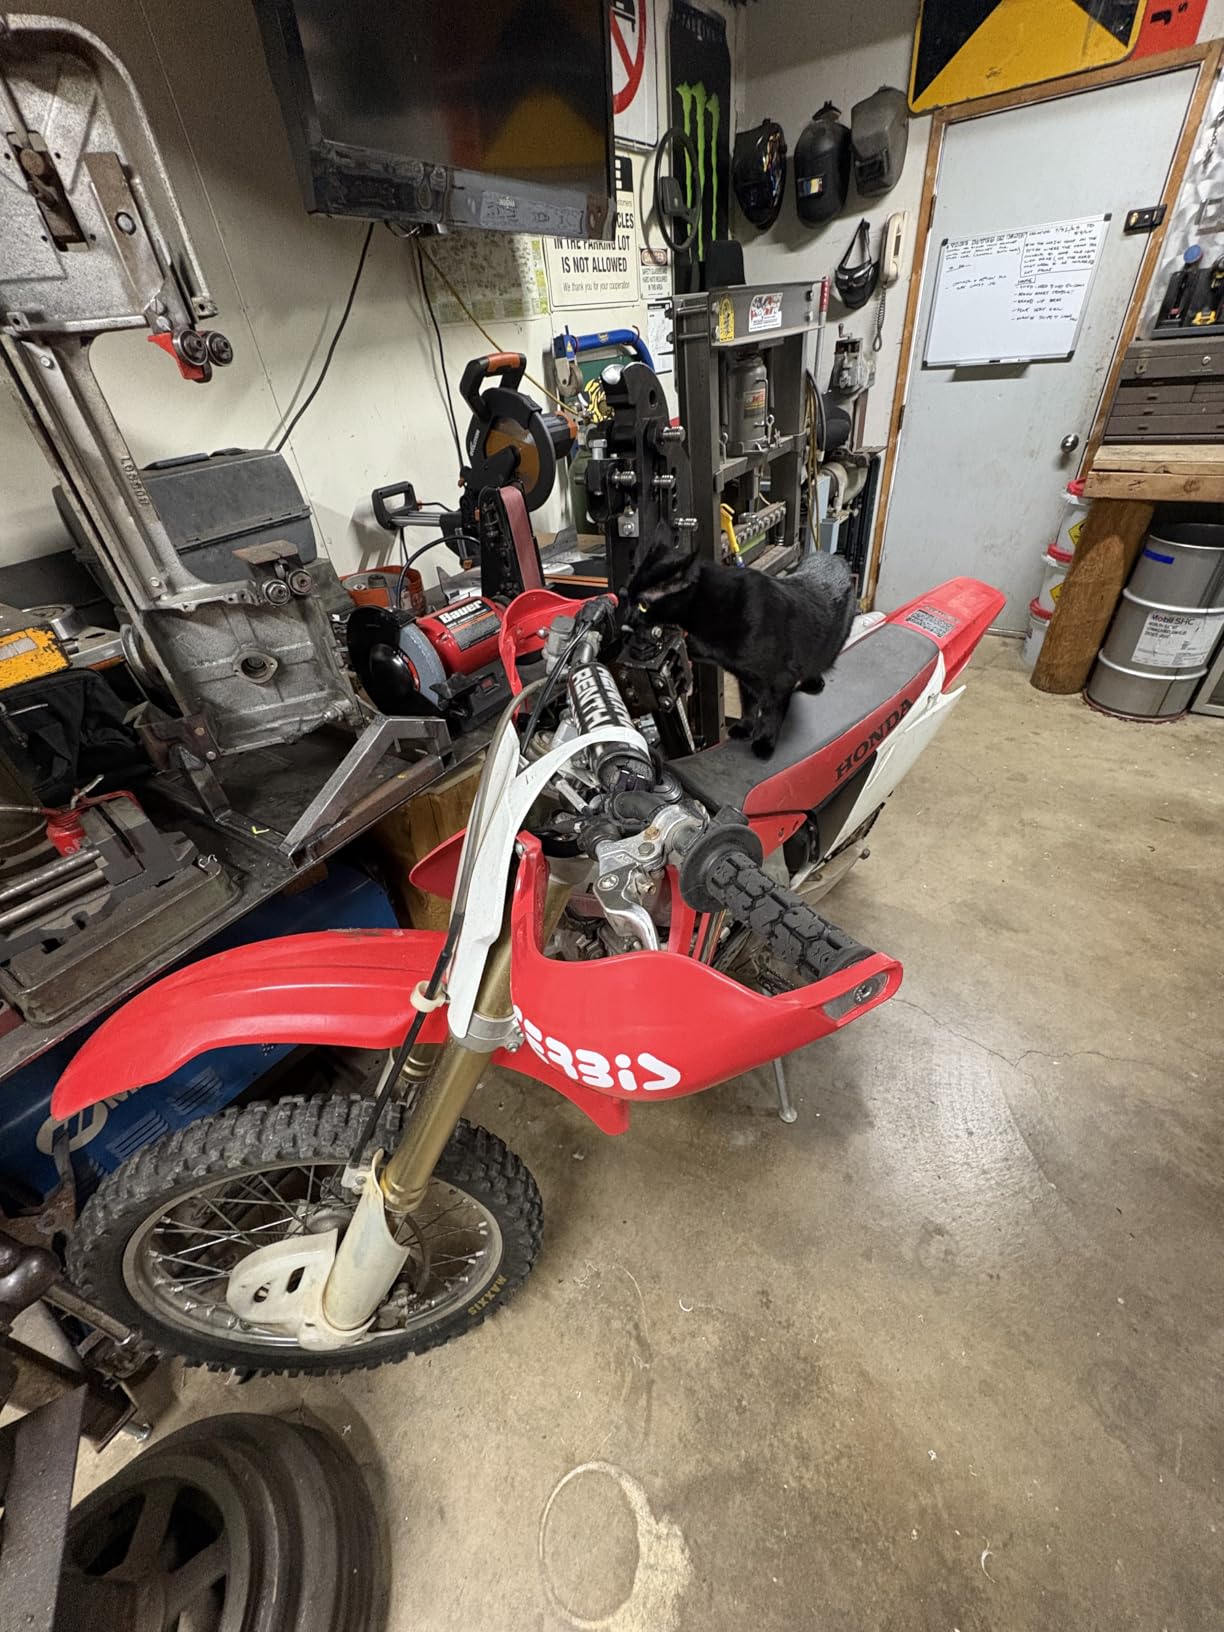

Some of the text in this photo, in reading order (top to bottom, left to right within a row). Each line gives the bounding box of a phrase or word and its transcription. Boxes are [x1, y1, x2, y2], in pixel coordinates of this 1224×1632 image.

[616, 212, 634, 229] CLES
[618, 235, 630, 251] LOT
[561, 256, 571, 273] IS
[573, 256, 589, 273] NOT
[592, 256, 628, 273] ALLOWED
[563, 282, 571, 292] We
[572, 281, 584, 292] thank
[600, 282, 608, 292] your
[609, 281, 630, 290] cooperation
[438, 600, 483, 624] Bauer
[1152, 614, 1196, 626] Mobil SHC
[572, 666, 614, 733] RENTH
[835, 698, 914, 780] HONDA
[468, 1274, 507, 1315] MAXXIS
